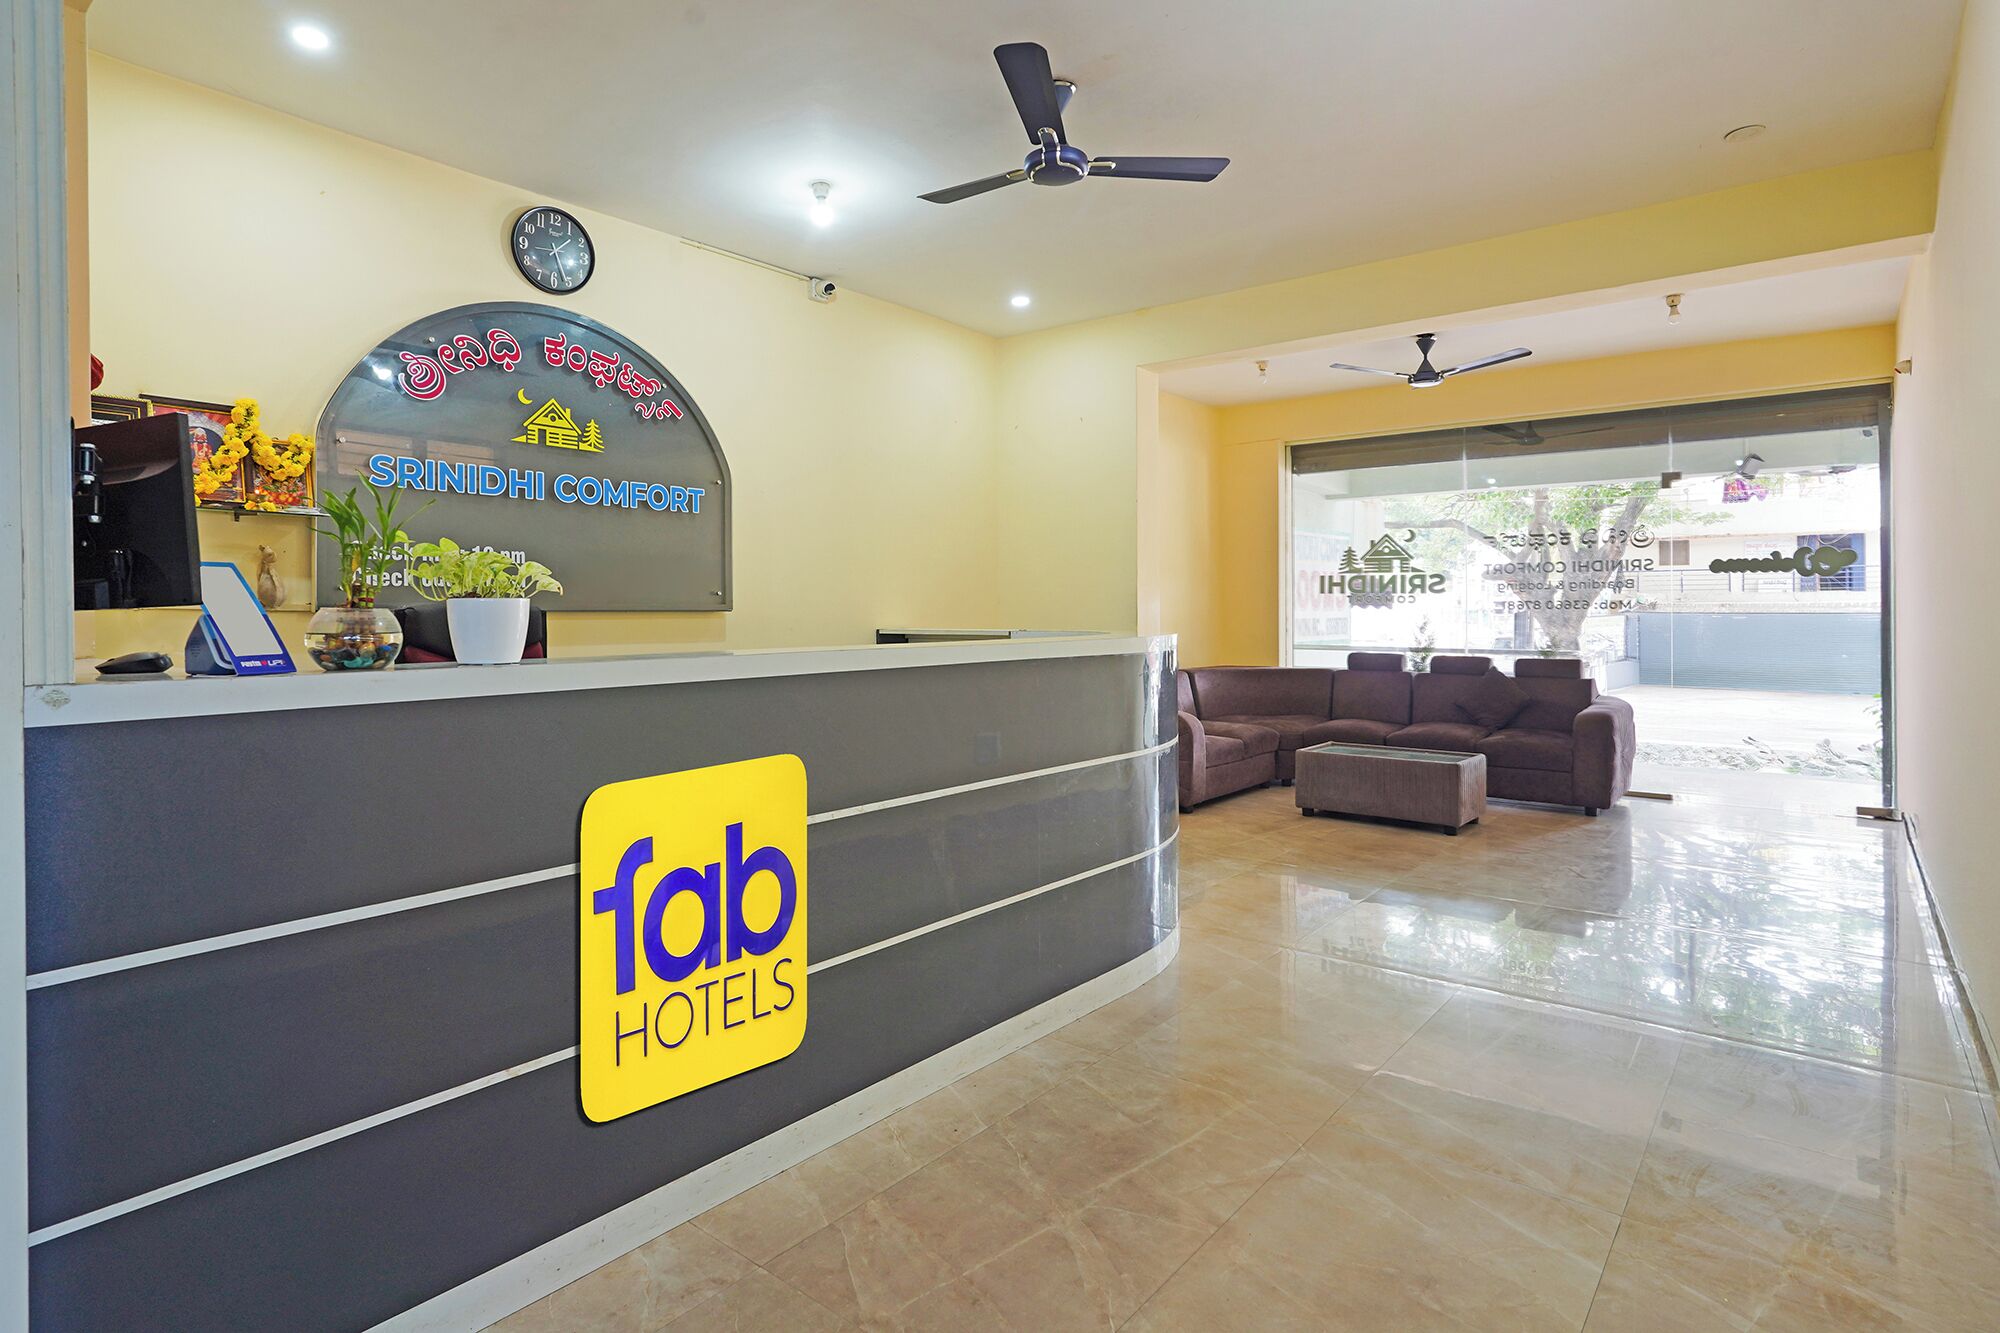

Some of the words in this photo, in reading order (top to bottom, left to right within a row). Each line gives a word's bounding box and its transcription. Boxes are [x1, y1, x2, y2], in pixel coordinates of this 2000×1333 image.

[537, 212, 545, 229] 11
[550, 212, 562, 227] 12
[524, 222, 535, 235] 10
[567, 221, 572, 236] 1
[519, 236, 529, 250] 9
[578, 237, 585, 248] 2
[523, 255, 531, 266] 8
[580, 252, 589, 265] 3
[536, 268, 543, 281] 7
[550, 271, 558, 289] 6
[566, 276, 573, 288] 5
[369, 453, 545, 501] SRINIDHI
[554, 473, 705, 514] COMFORT
[351, 540, 413, 561] eck
[593, 821, 797, 996] fab
[615, 957, 795, 1067] HOTELS
